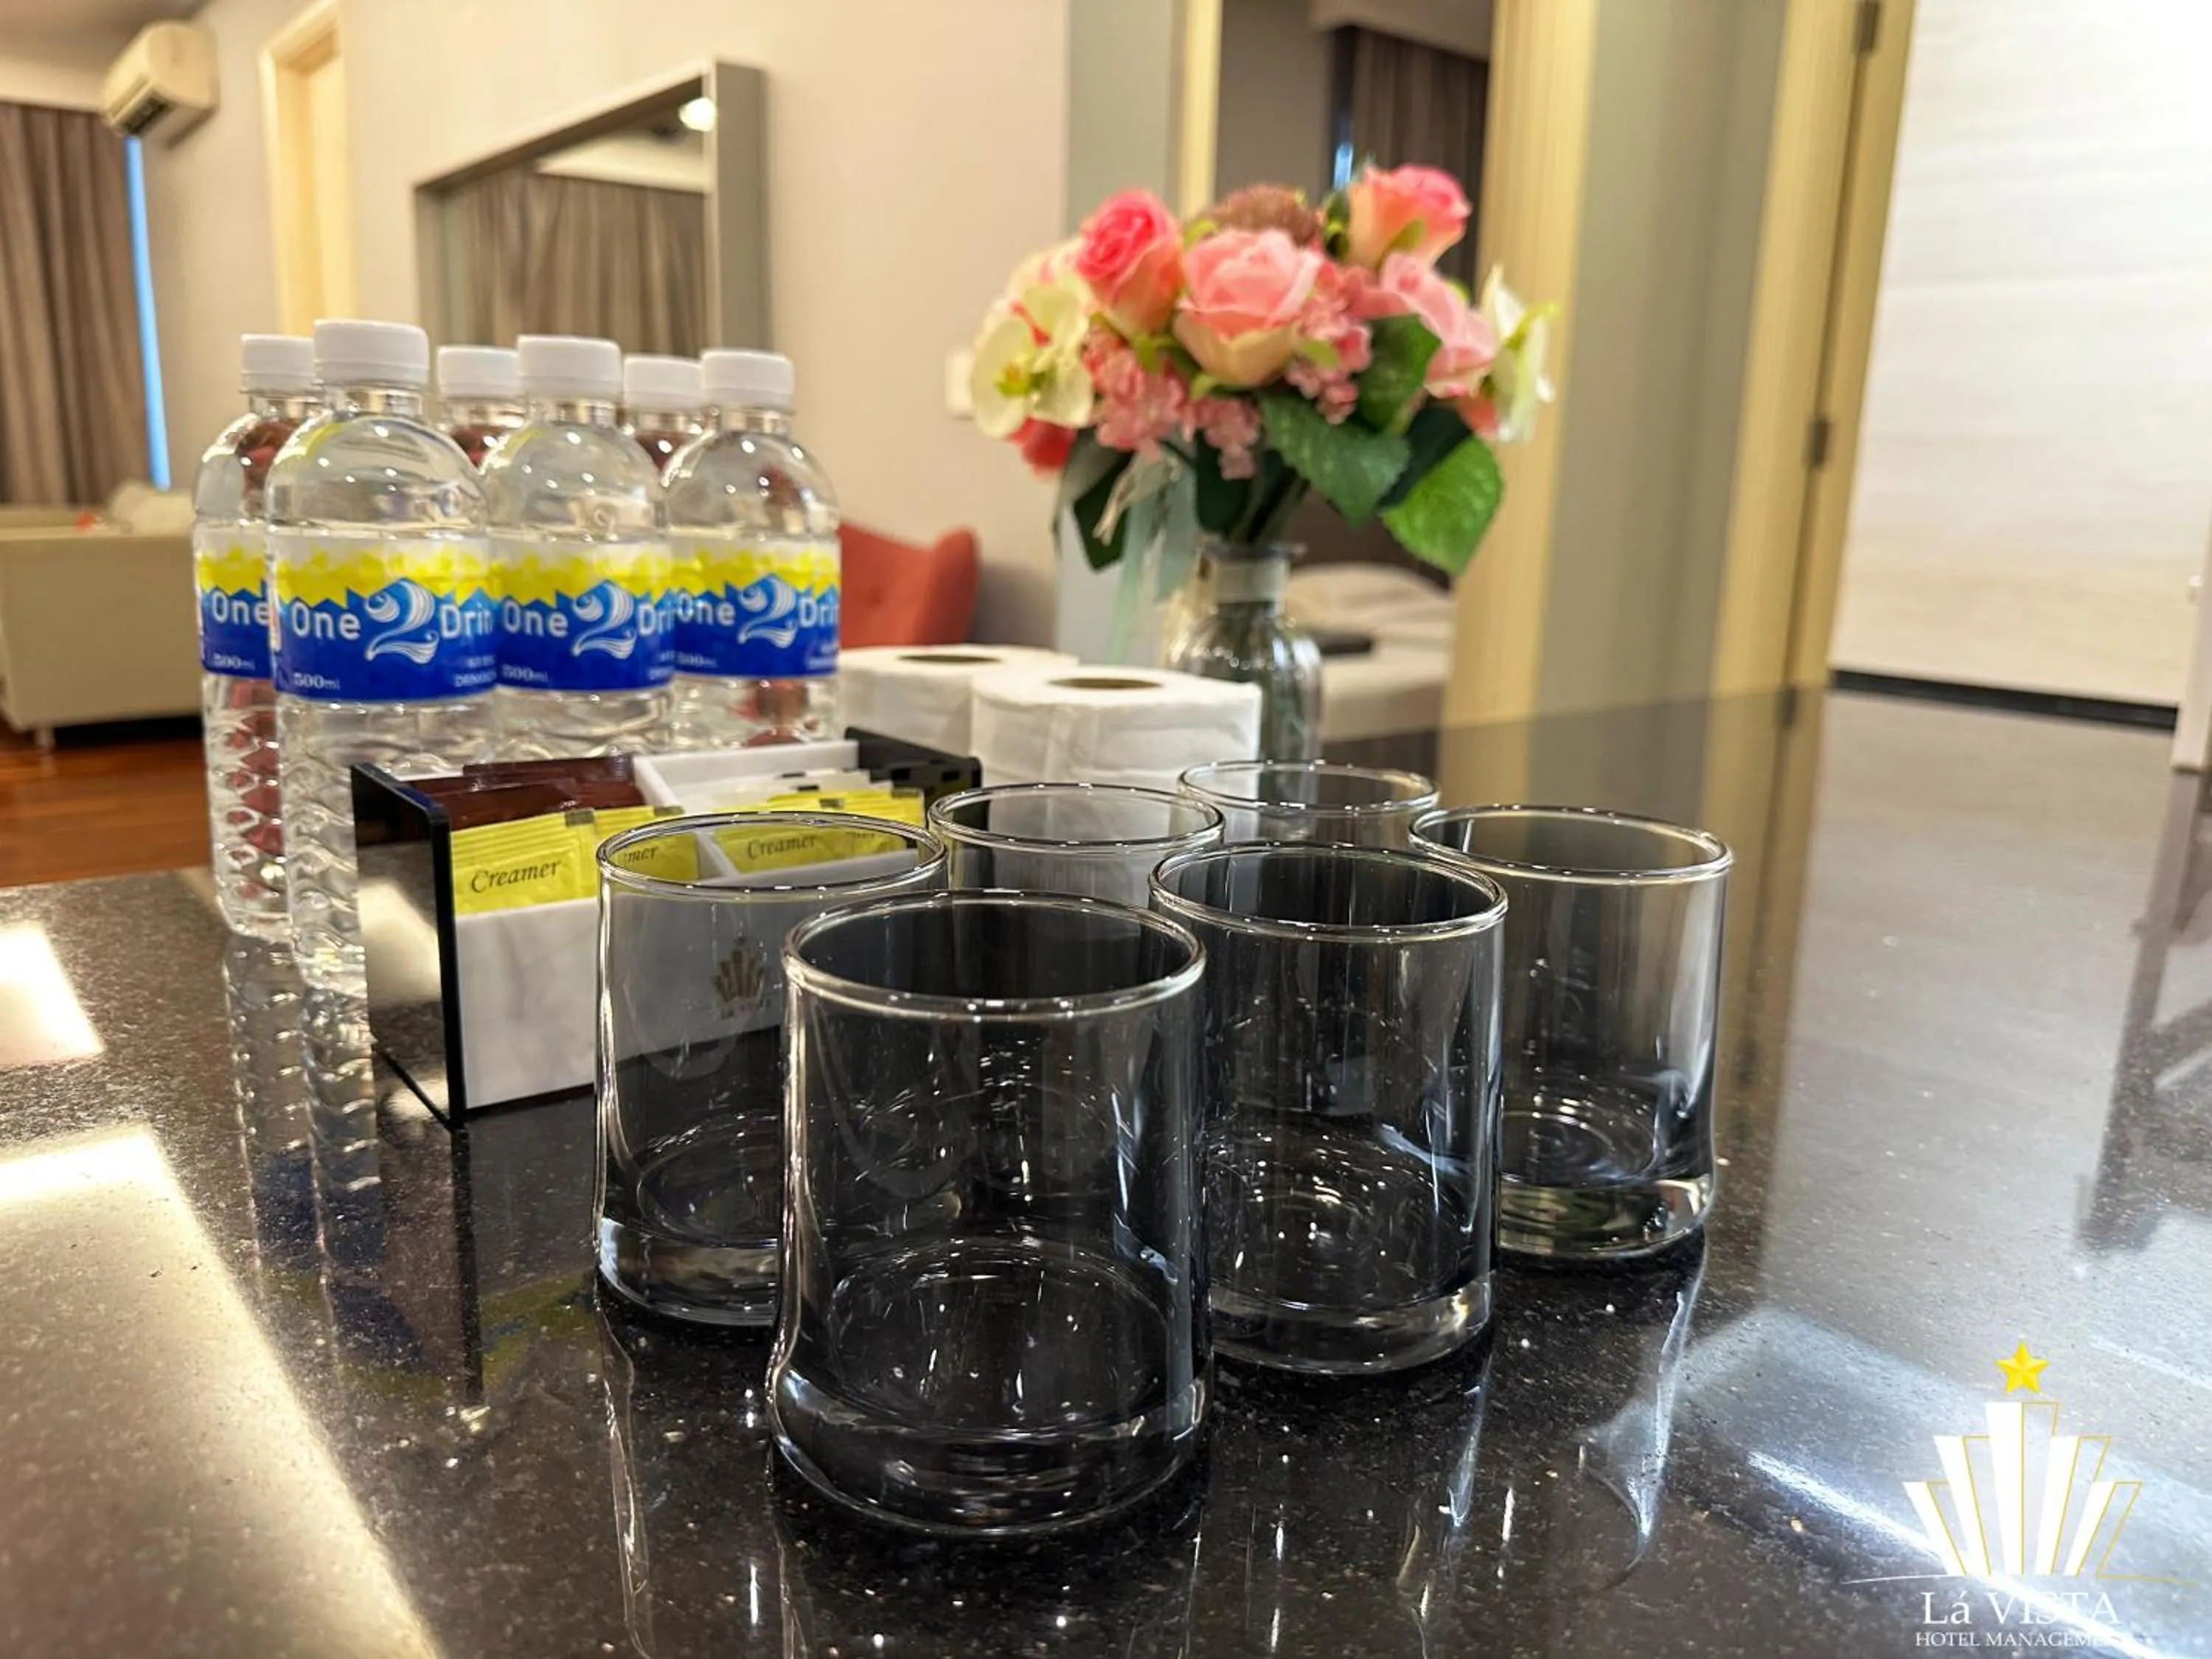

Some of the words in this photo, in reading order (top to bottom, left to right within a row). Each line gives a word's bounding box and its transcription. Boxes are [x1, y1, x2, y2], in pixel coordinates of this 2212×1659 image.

[212, 590, 271, 626] One
[291, 601, 361, 641] One
[364, 579, 440, 664] 2
[502, 599, 568, 638] One
[638, 603, 675, 636] Dri
[678, 592, 736, 626] One
[293, 672, 341, 690] 500ml
[624, 846, 659, 863] mer
[748, 834, 818, 860] Creamer
[471, 860, 562, 894] Creamer
